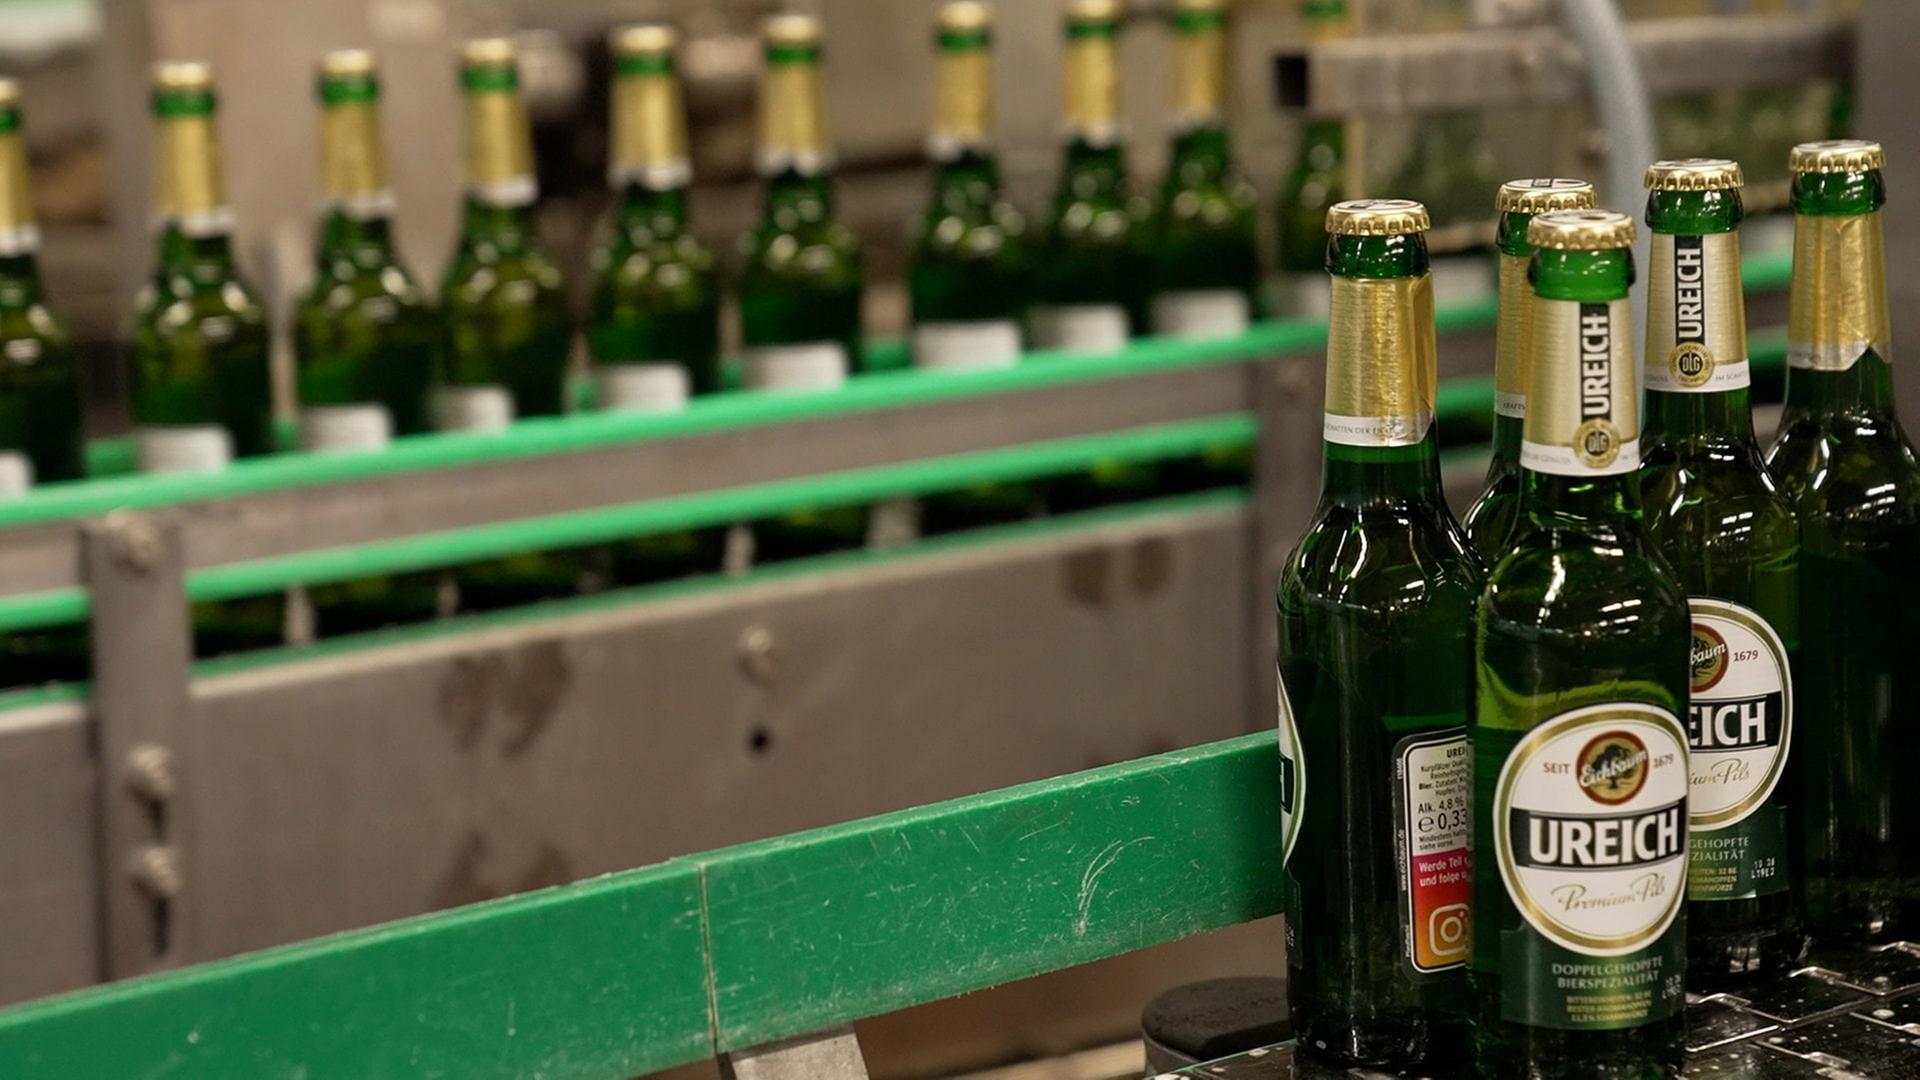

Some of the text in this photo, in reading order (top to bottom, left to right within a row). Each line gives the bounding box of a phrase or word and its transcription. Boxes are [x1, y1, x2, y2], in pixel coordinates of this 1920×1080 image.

[1677, 248, 1702, 338] UREICH
[1582, 316, 1610, 415] UREICH
[1733, 649, 1759, 662] 1679
[1544, 762, 1571, 774] SEIT
[1418, 802, 1436, 814] Alk.
[1529, 809, 1678, 865] UREICH
[1688, 836, 1750, 849] GEHOPFTE
[1419, 858, 1447, 873] Werde
[1449, 854, 1463, 867] Teil
[1691, 847, 1745, 861] ZIALITÄT
[1419, 874, 1437, 887] und
[1439, 871, 1460, 884] folge
[1551, 884, 1637, 912] Premium
[1552, 955, 1663, 975] DOPPELGEHOPFTE
[1558, 970, 1659, 990] BIERSPEZIALITÄT
